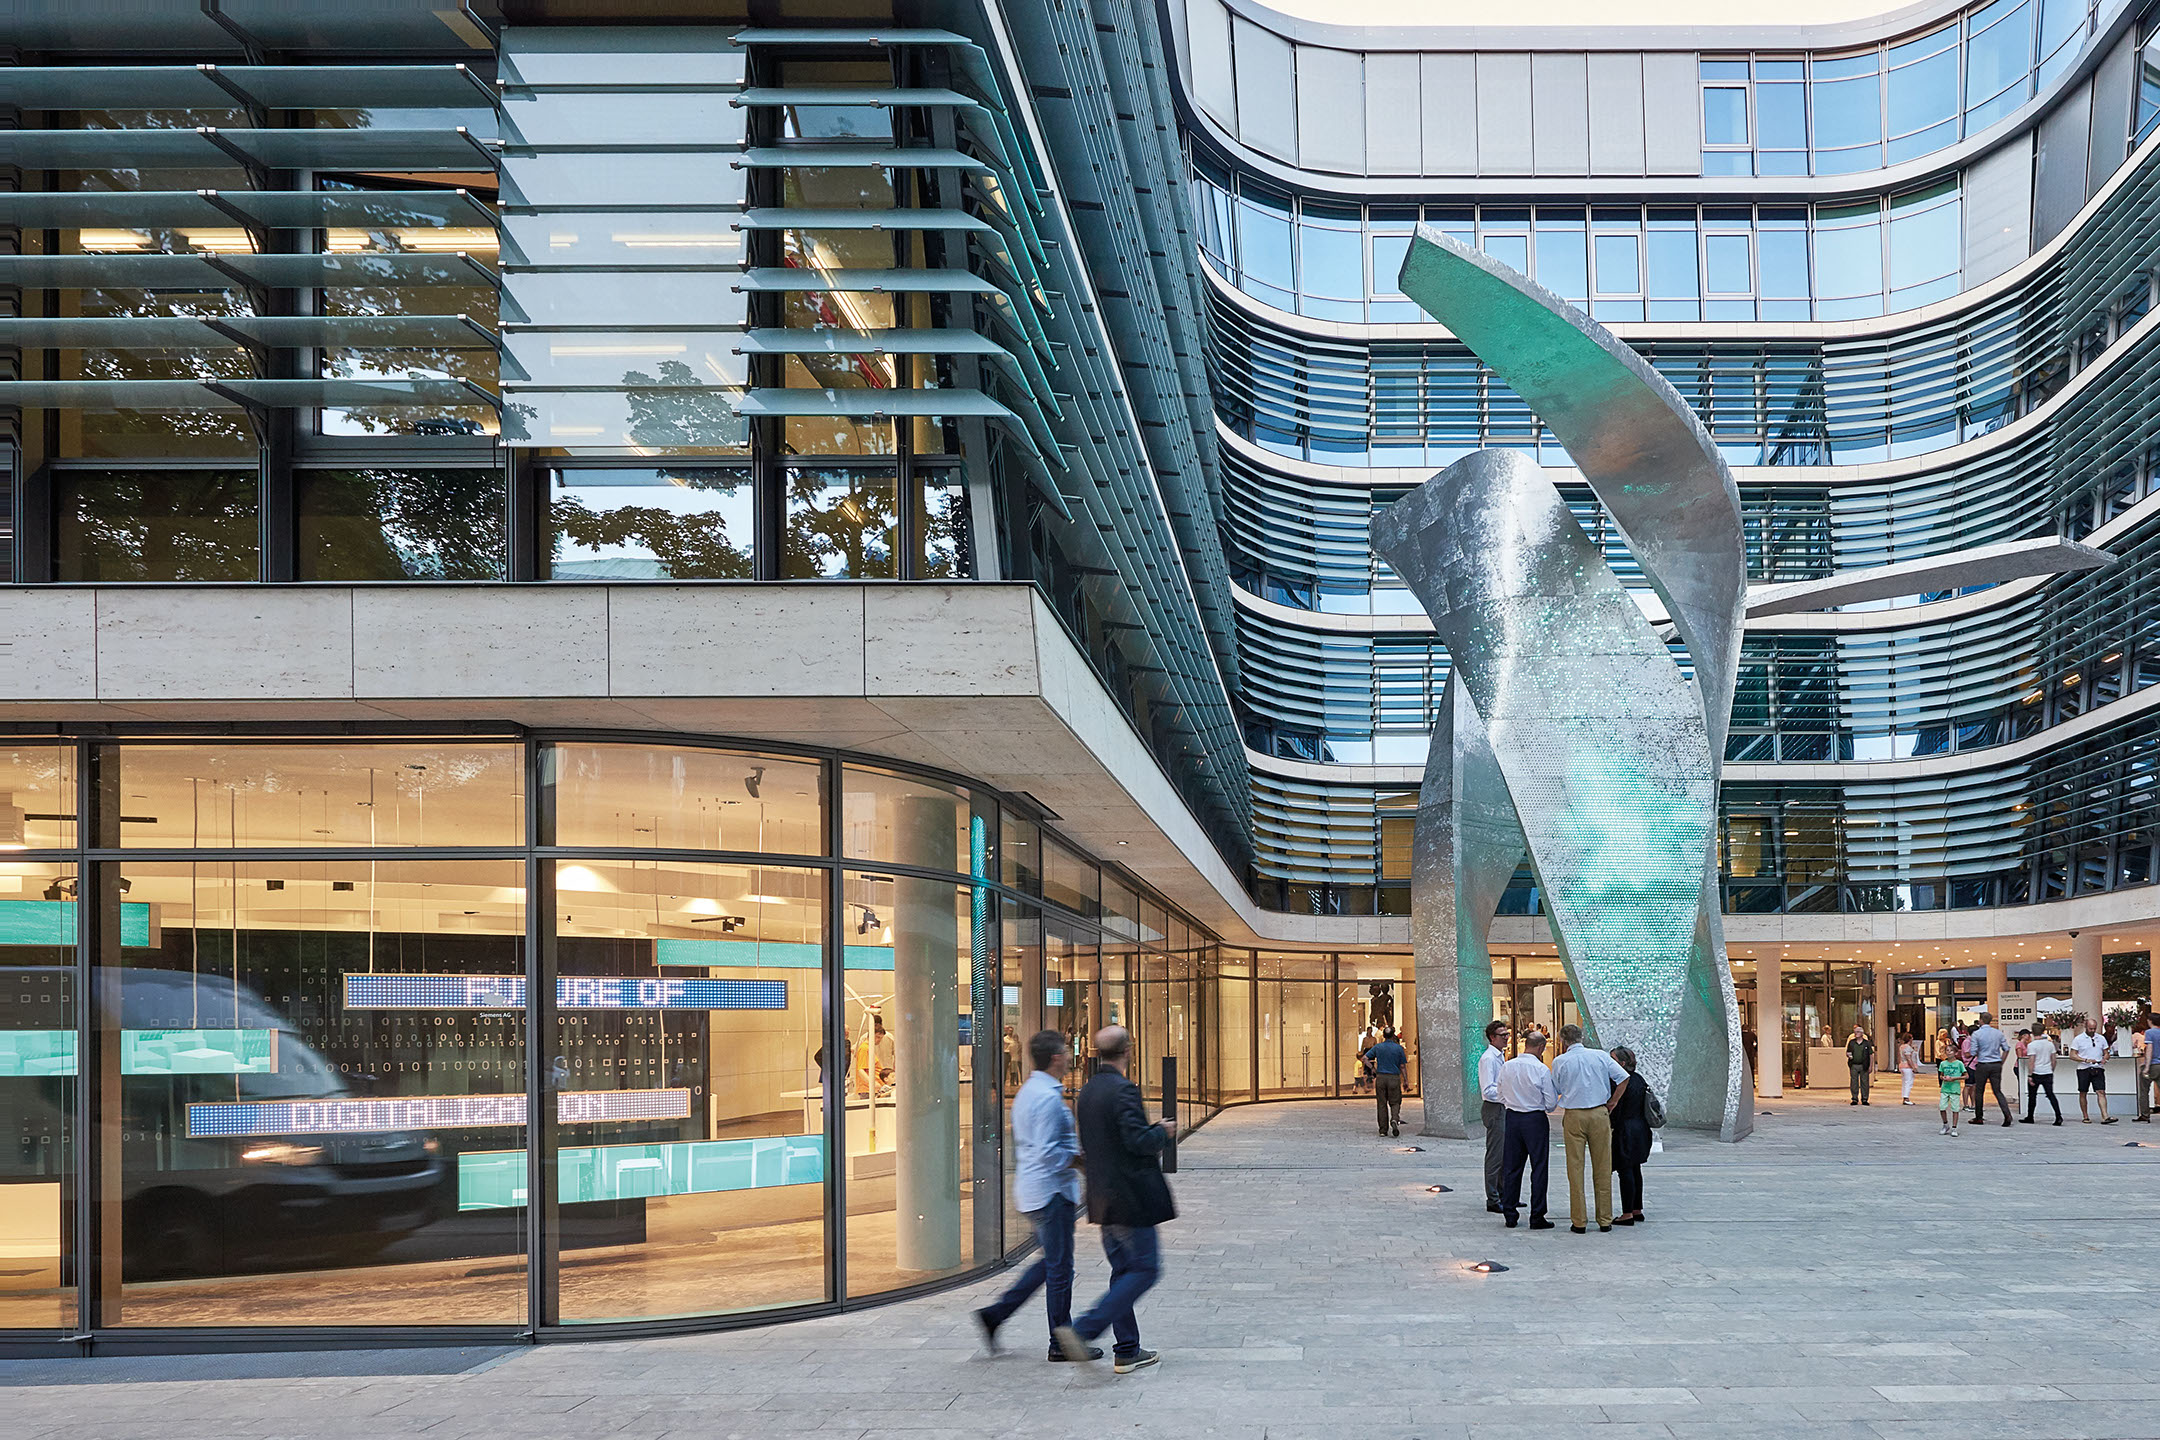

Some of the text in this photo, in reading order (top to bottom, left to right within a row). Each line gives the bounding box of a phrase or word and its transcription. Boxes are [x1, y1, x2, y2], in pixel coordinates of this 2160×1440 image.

[466, 976, 684, 1005] FUURE OF
[291, 1093, 605, 1129] DIGITALIZAON
